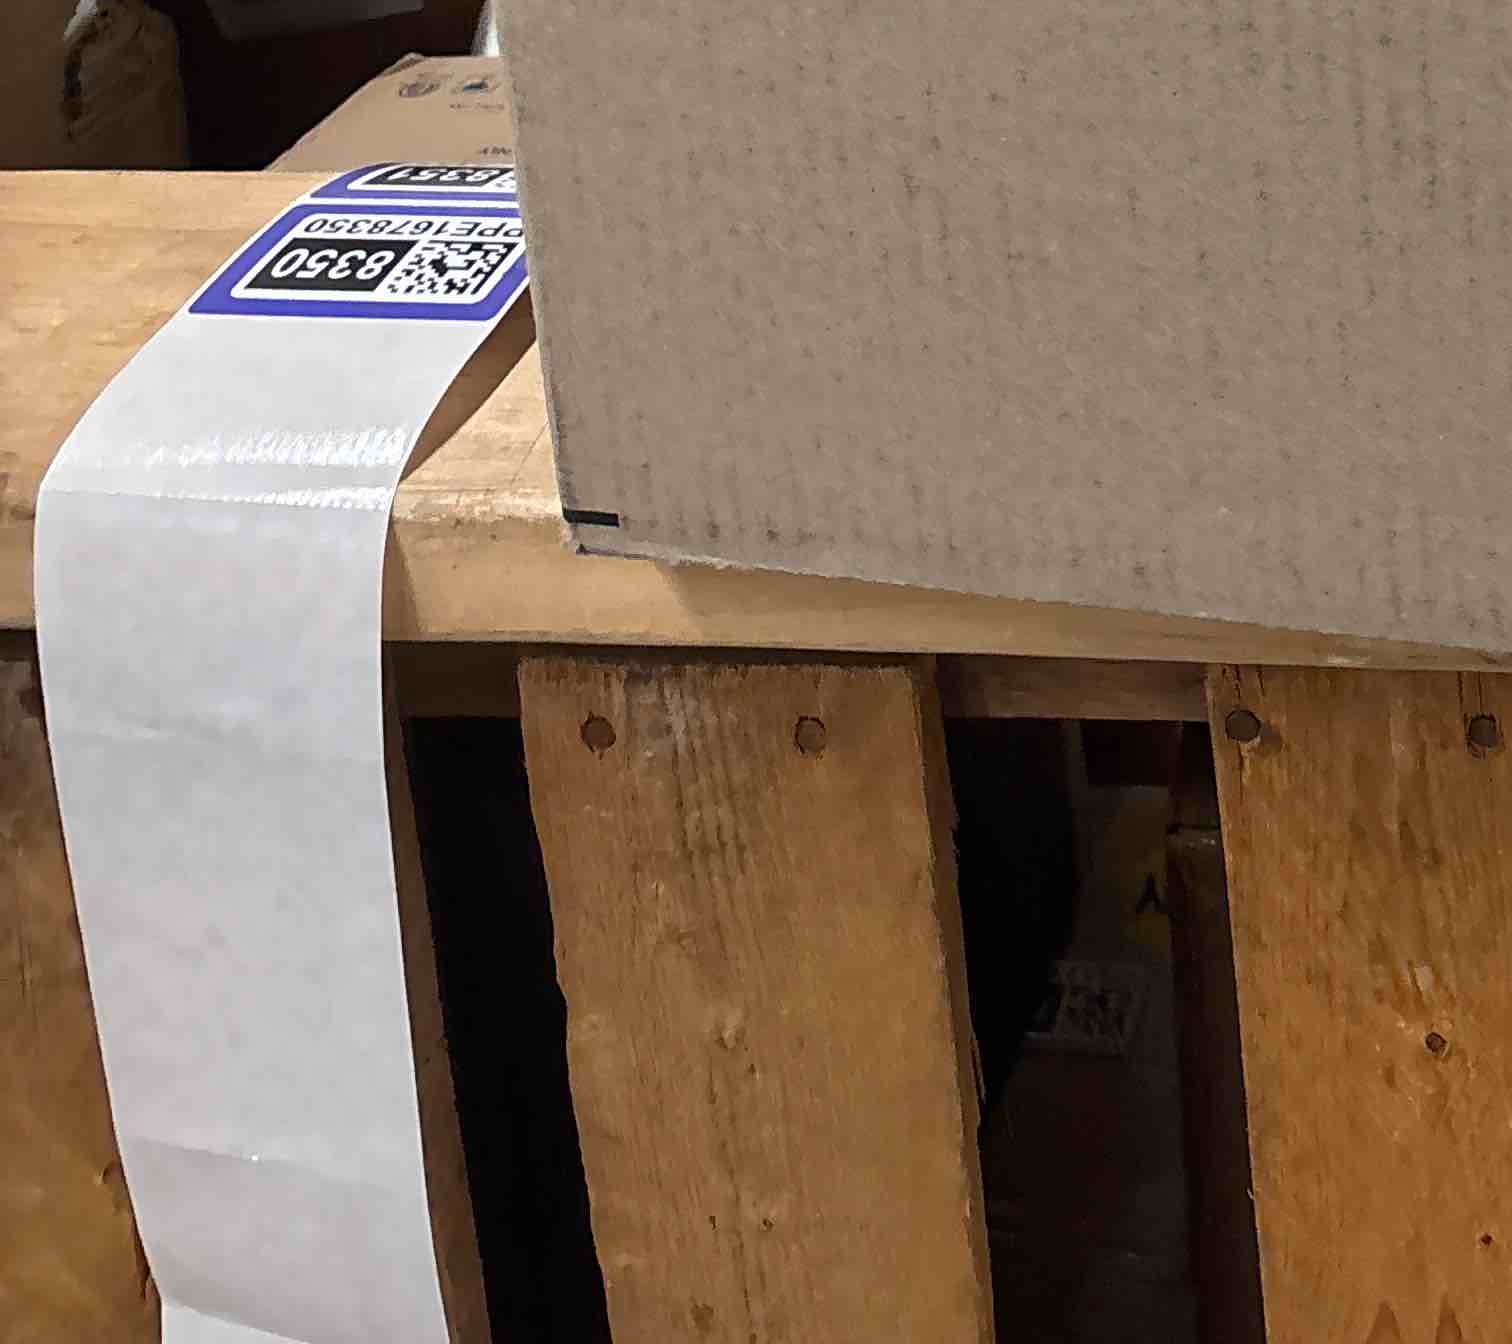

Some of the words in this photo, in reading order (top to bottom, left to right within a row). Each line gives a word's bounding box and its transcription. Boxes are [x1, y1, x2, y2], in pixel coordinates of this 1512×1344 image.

[387, 168, 501, 182] 8351
[303, 217, 524, 238] PPE1678350
[271, 248, 395, 280] 8350
